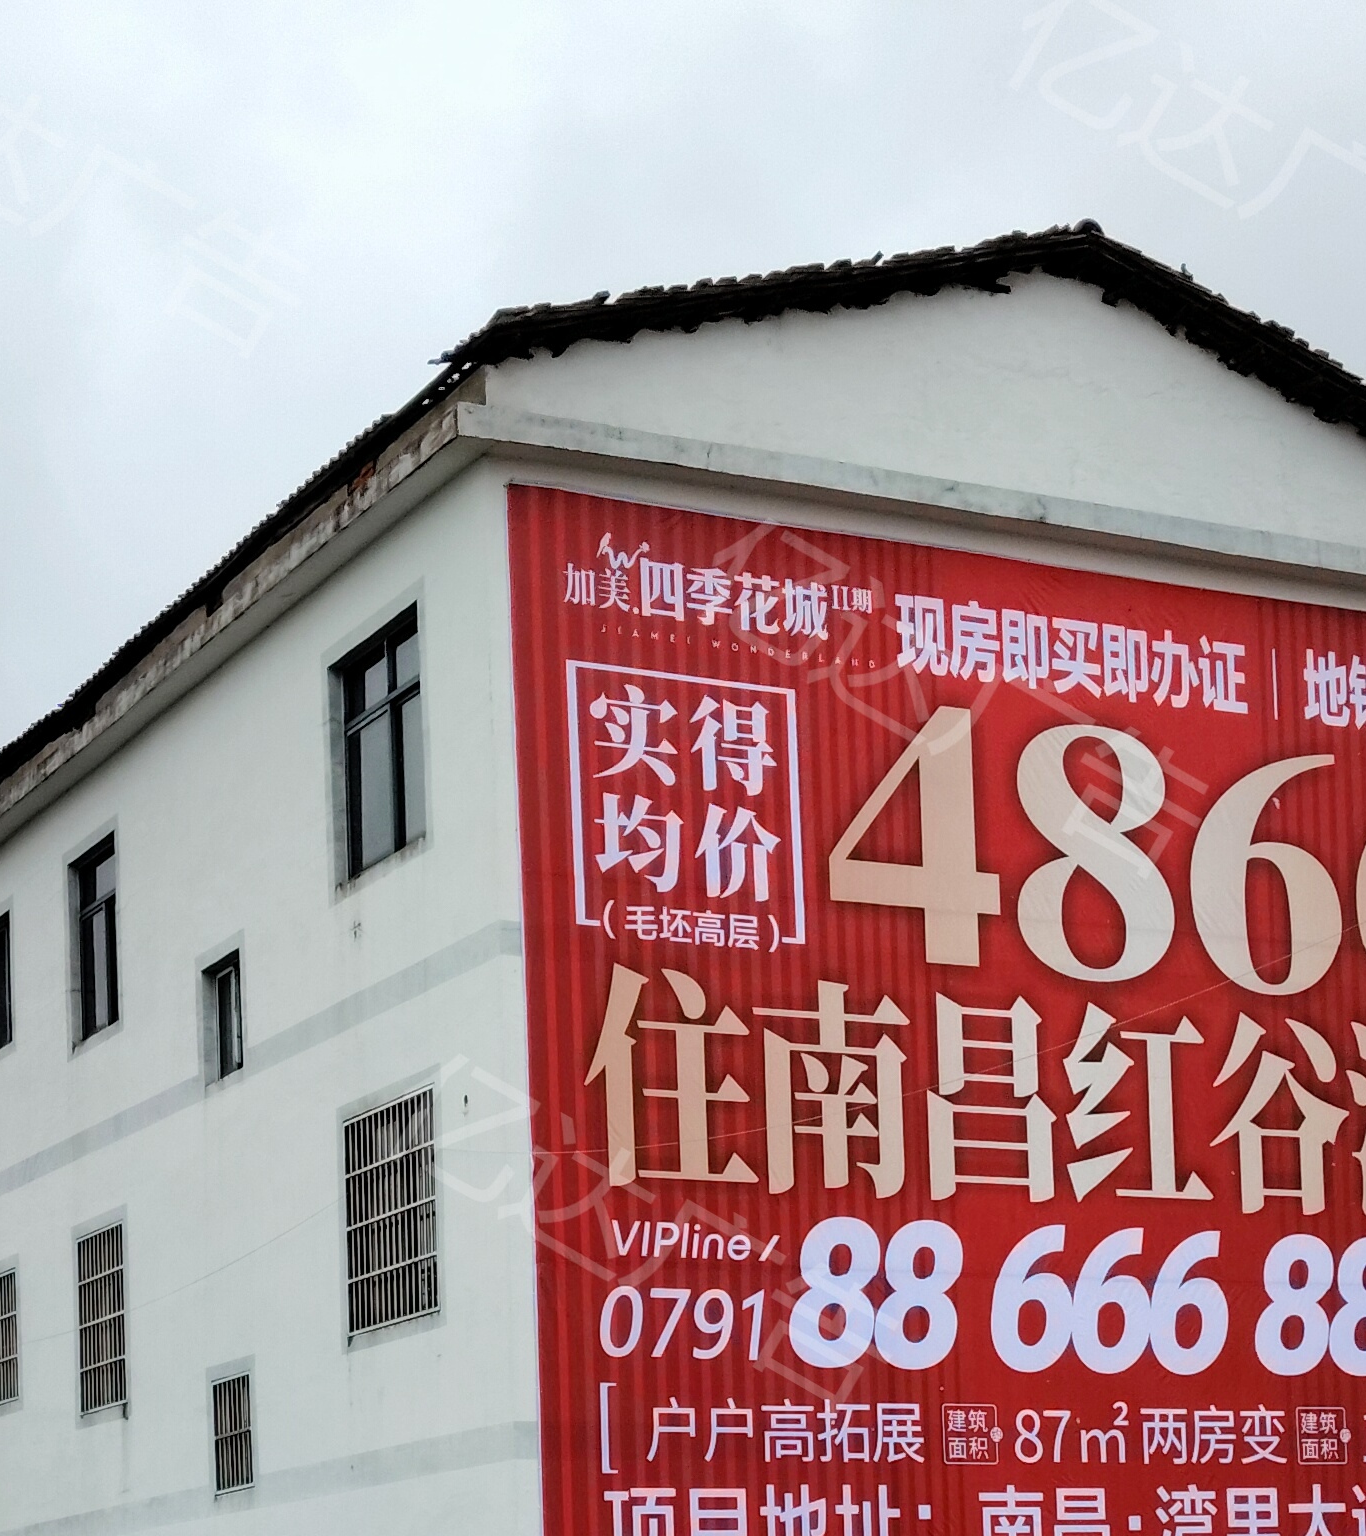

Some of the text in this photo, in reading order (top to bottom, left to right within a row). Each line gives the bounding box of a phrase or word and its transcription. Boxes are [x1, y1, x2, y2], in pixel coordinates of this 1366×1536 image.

[895, 592, 1248, 716] 现房即买即办证
[589, 684, 778, 796] 实得
[594, 792, 781, 902] 均价
[599, 1285, 766, 1361] 0791
[788, 1216, 963, 1370] 88
[991, 1224, 1229, 1376] 666
[647, 1396, 925, 1464] 户户高拓展
